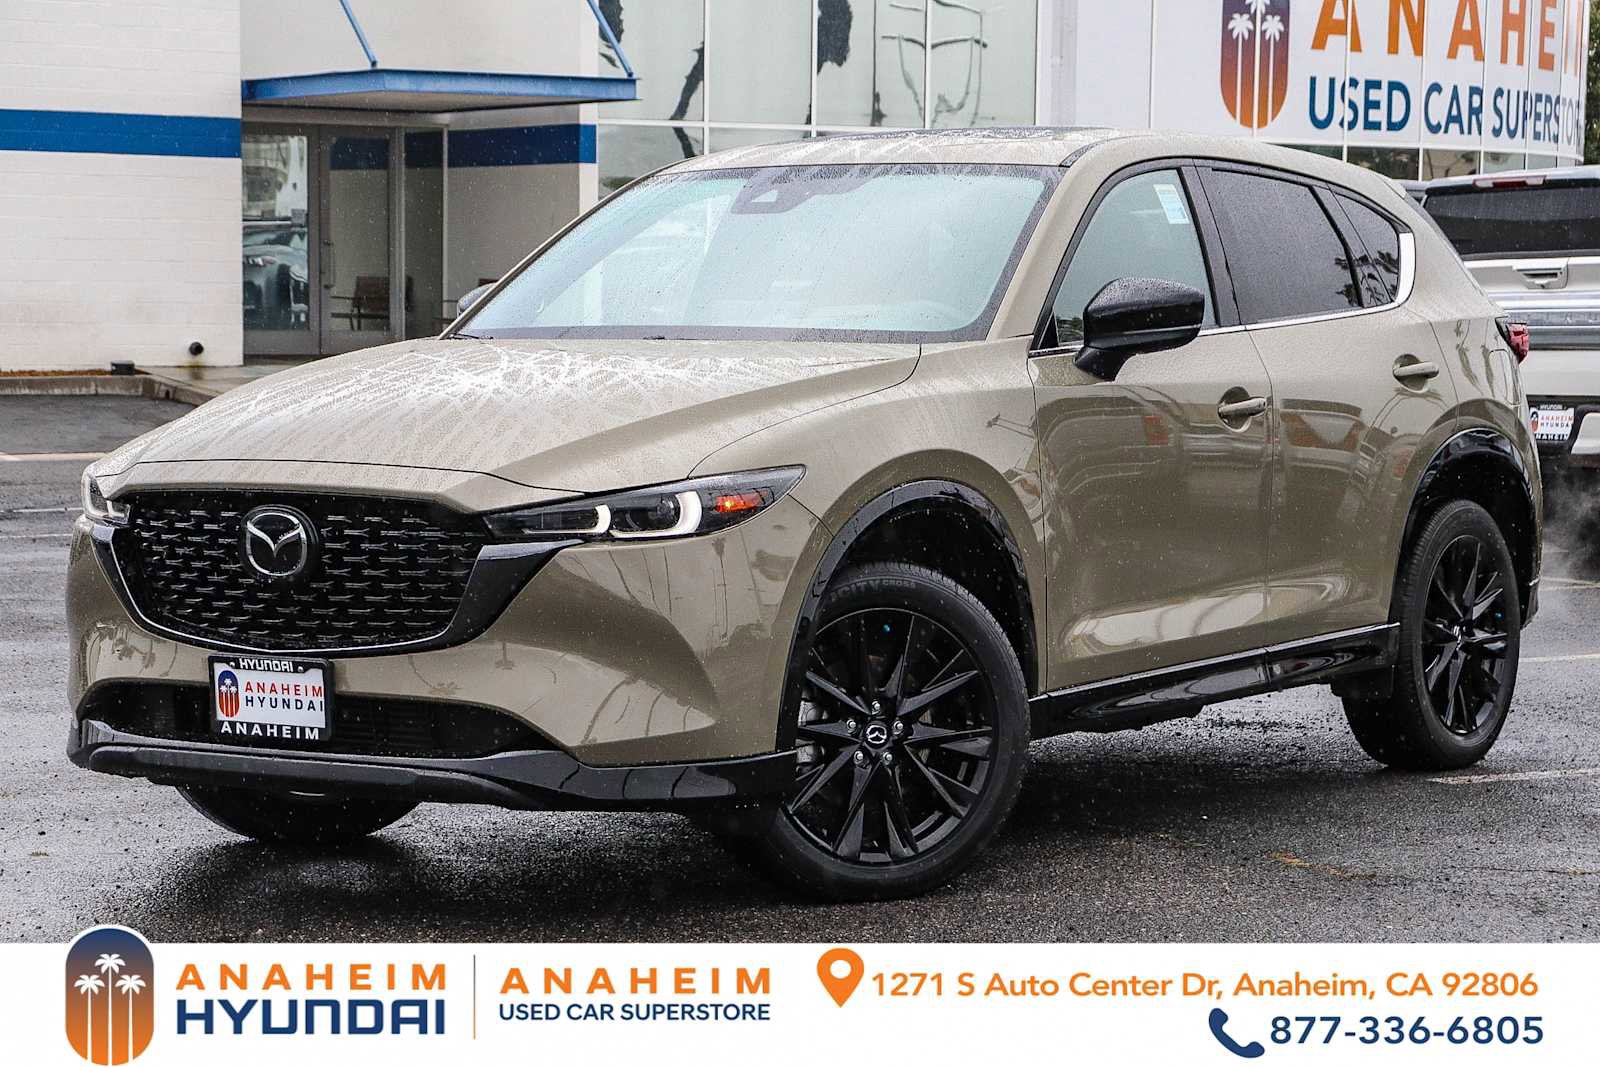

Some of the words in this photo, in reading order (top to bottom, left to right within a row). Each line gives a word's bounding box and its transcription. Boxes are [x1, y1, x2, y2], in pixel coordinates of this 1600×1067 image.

[1311, 0, 1583, 76] ANAHEI
[1307, 76, 1412, 132] USED
[1423, 82, 1484, 136] CAR
[881, 579, 916, 589] CROSS
[239, 658, 294, 672] HYUNDAI
[245, 681, 323, 698] ANAHEIM
[245, 696, 323, 712] HYUNDAI
[220, 721, 320, 740] ANAHEIM
